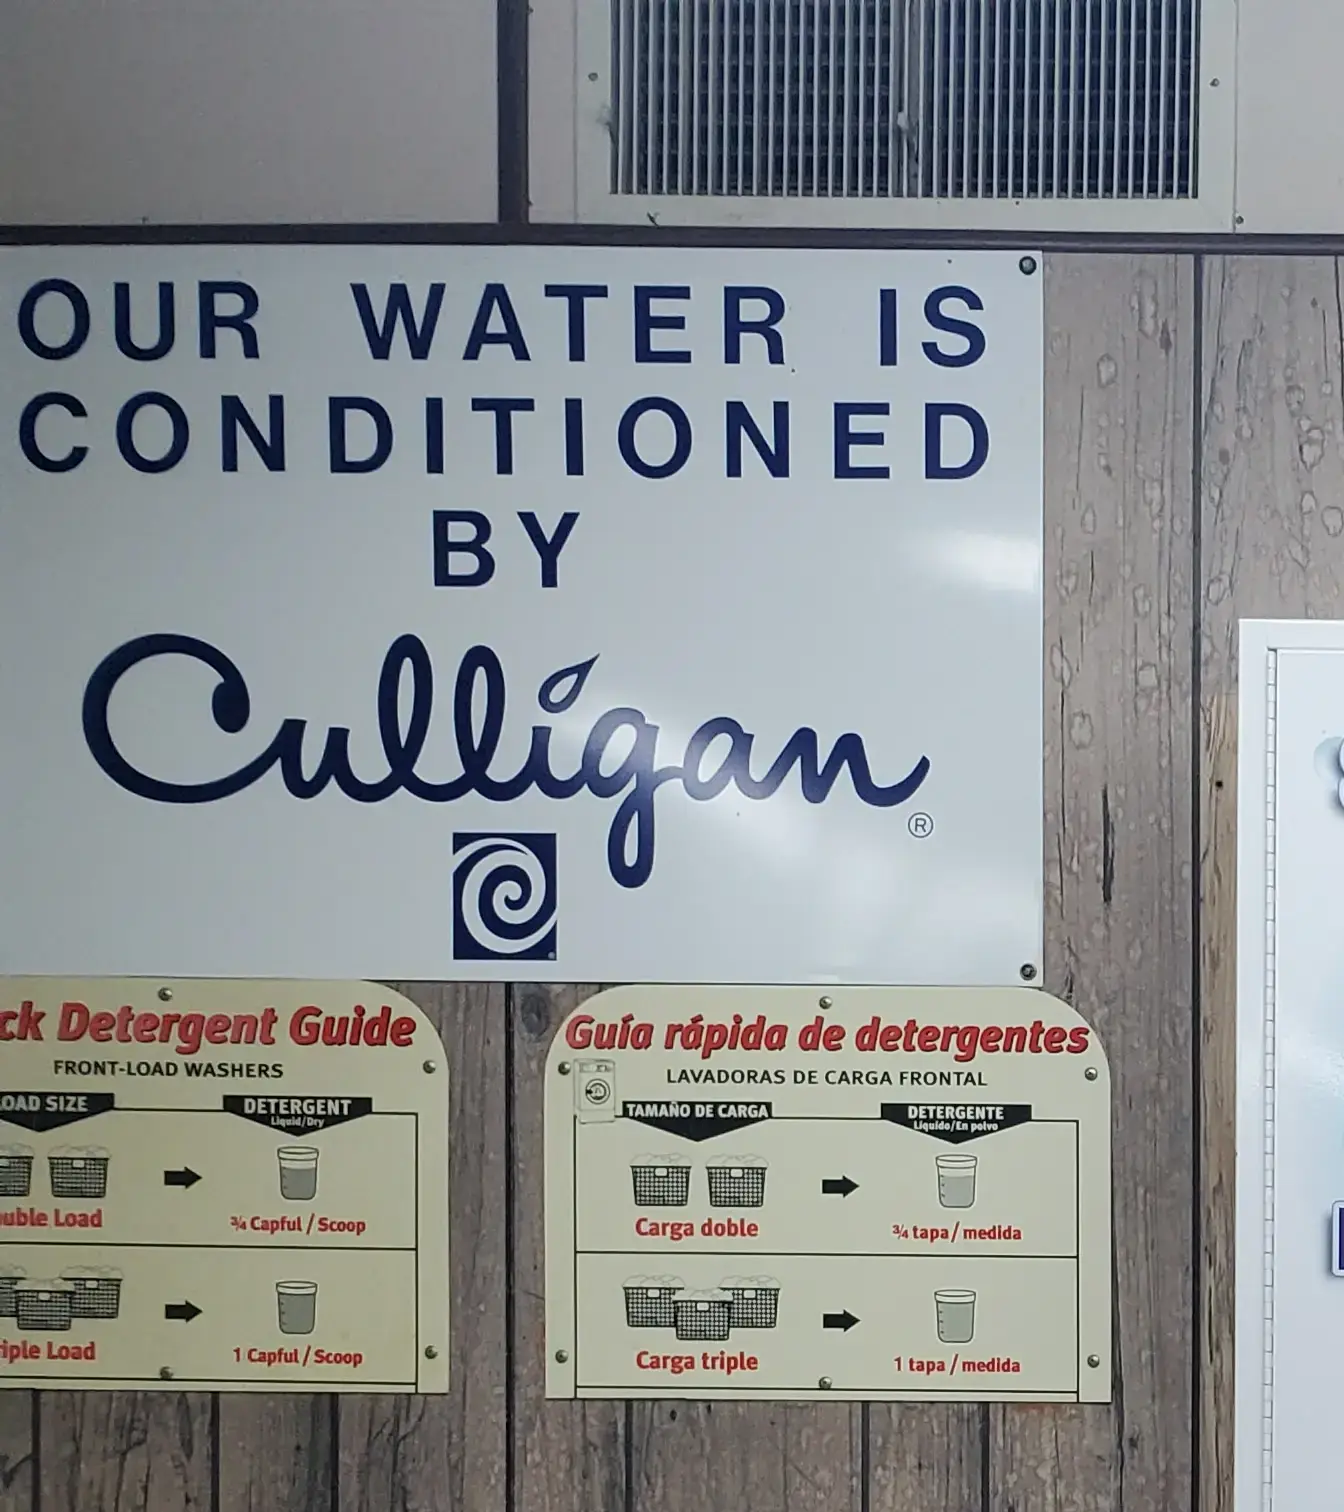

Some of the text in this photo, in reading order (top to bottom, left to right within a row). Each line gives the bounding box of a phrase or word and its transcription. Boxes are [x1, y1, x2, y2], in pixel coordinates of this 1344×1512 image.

[17, 278, 985, 367] OUR WATER IS
[19, 392, 990, 479] CONDITIONED
[434, 510, 579, 587] BY
[82, 633, 930, 888] Culligan
[58, 1002, 277, 1055] Detergent
[289, 1006, 416, 1047] Guide
[566, 1014, 1090, 1062] Guía rápida de detergentes
[54, 1060, 284, 1078] FRONT-LOAD WASHERS
[667, 1069, 988, 1087] LAVADORAS DE CARGA FRONTAL
[0, 1095, 88, 1112] OAD SIZE
[244, 1098, 351, 1115] DETERGENT
[626, 1102, 769, 1119] TAMAÑO DE CARGA
[908, 1106, 1004, 1120] DETERGENTE
[271, 1117, 324, 1128] Liquid/Dry
[971, 1122, 998, 1132] polvo
[54, 1209, 102, 1227] Load
[250, 1215, 302, 1237] Capful
[318, 1217, 366, 1237] Scoop
[636, 1217, 759, 1243] Carga doble
[912, 1226, 952, 1245] tapa
[962, 1225, 1022, 1241] medida
[0, 1339, 95, 1364] iple Load
[234, 1347, 241, 1363] 1
[247, 1346, 299, 1367] Capful
[314, 1348, 363, 1367] Scoop
[637, 1351, 759, 1376] Carga triple
[894, 1357, 902, 1373] 1
[909, 1358, 947, 1377] tapa
[961, 1357, 1021, 1373] medida
